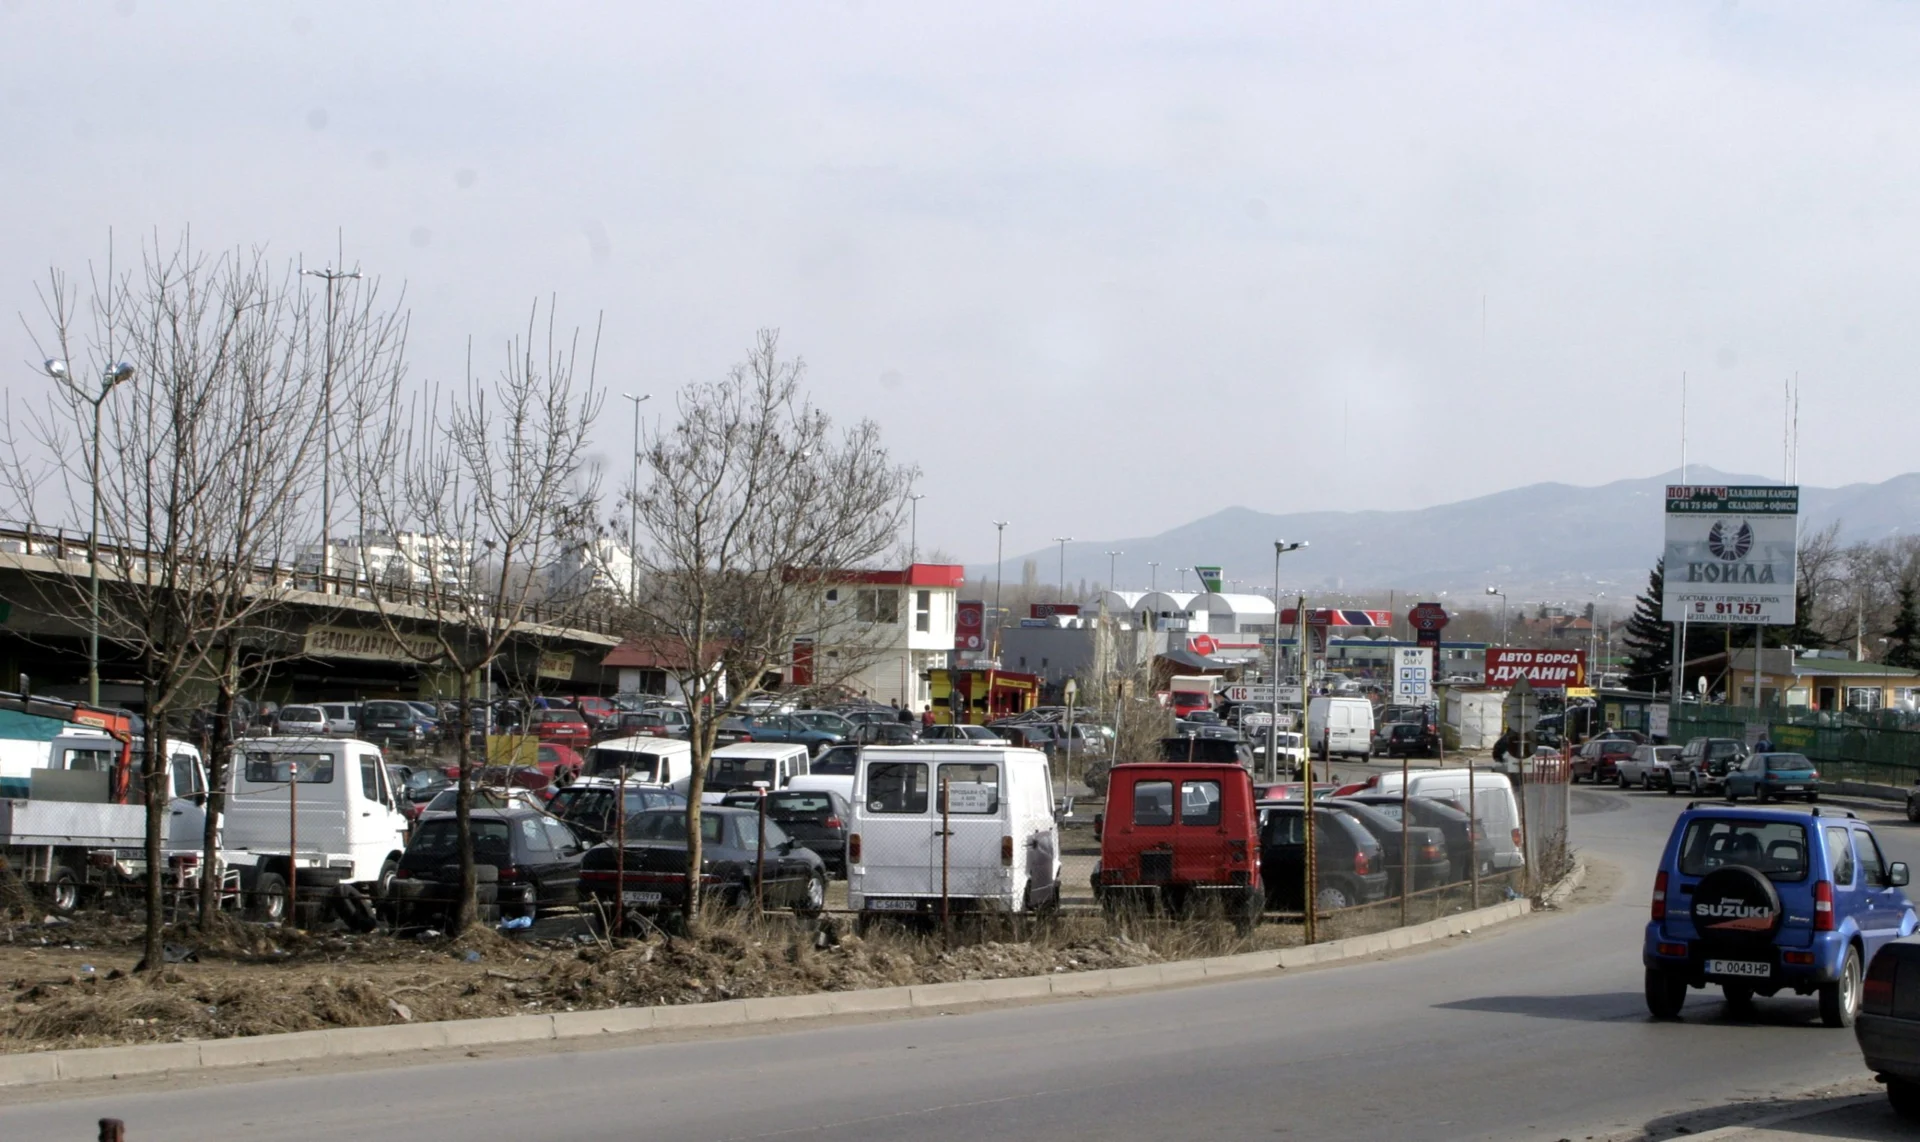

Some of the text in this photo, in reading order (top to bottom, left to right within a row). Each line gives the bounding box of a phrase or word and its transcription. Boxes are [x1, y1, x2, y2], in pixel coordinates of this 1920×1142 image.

[1668, 487, 1726, 499] ПОД АМ
[1768, 489, 1797, 499] КАМЕРИ
[1728, 501, 1797, 511] СКЛАДОВЕ ОФИСИ
[1716, 603, 1762, 615] 91 757
[1686, 613, 1772, 622] БЕЗПЛАТЕН ТРАНСПОРТ
[1498, 652, 1579, 664] АВТО БОРСА
[1493, 665, 1569, 681] ДЖАНИ
[1231, 687, 1248, 700] IEC
[1695, 903, 1770, 919] SUZUKI
